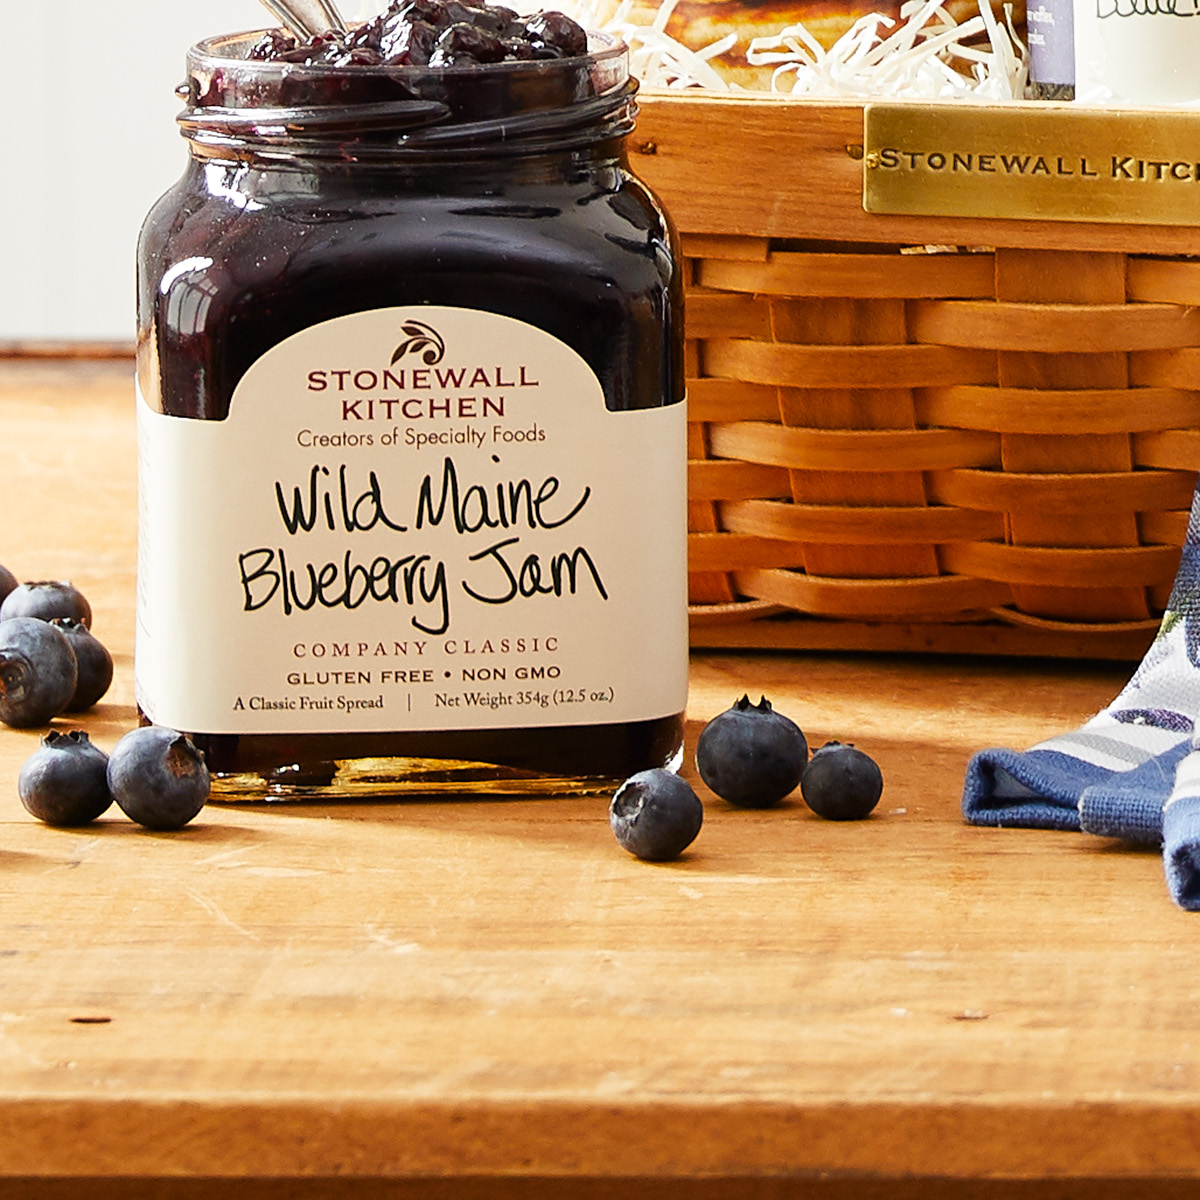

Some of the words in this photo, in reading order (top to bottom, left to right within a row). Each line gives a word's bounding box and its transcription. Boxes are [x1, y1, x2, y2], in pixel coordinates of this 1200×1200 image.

[879, 148, 1098, 177] STONEWALL
[307, 365, 539, 391] STONEWALL
[341, 396, 505, 420] KITCHEN
[296, 430, 374, 449] Creators
[380, 427, 399, 447] of
[404, 427, 486, 451] Specialty
[494, 424, 546, 443] Foods
[275, 464, 408, 535] Wild
[416, 454, 591, 534] Maine
[238, 547, 448, 635] Blueberry
[462, 537, 608, 604] Jam
[293, 640, 428, 658] COMPANY
[443, 637, 559, 655] CLASSIC
[287, 671, 371, 685] GLUTEN
[381, 670, 434, 683] FREE
[462, 668, 507, 682] NON
[515, 666, 561, 680] GMO
[233, 697, 246, 711] A
[249, 696, 296, 711] Classic
[298, 695, 333, 710] Fruit
[337, 695, 384, 713] Spread
[434, 693, 460, 707] Net
[463, 692, 513, 710] Weight
[516, 691, 550, 708] 354g
[552, 688, 587, 706] (12.5
[590, 686, 615, 704] oz.)
